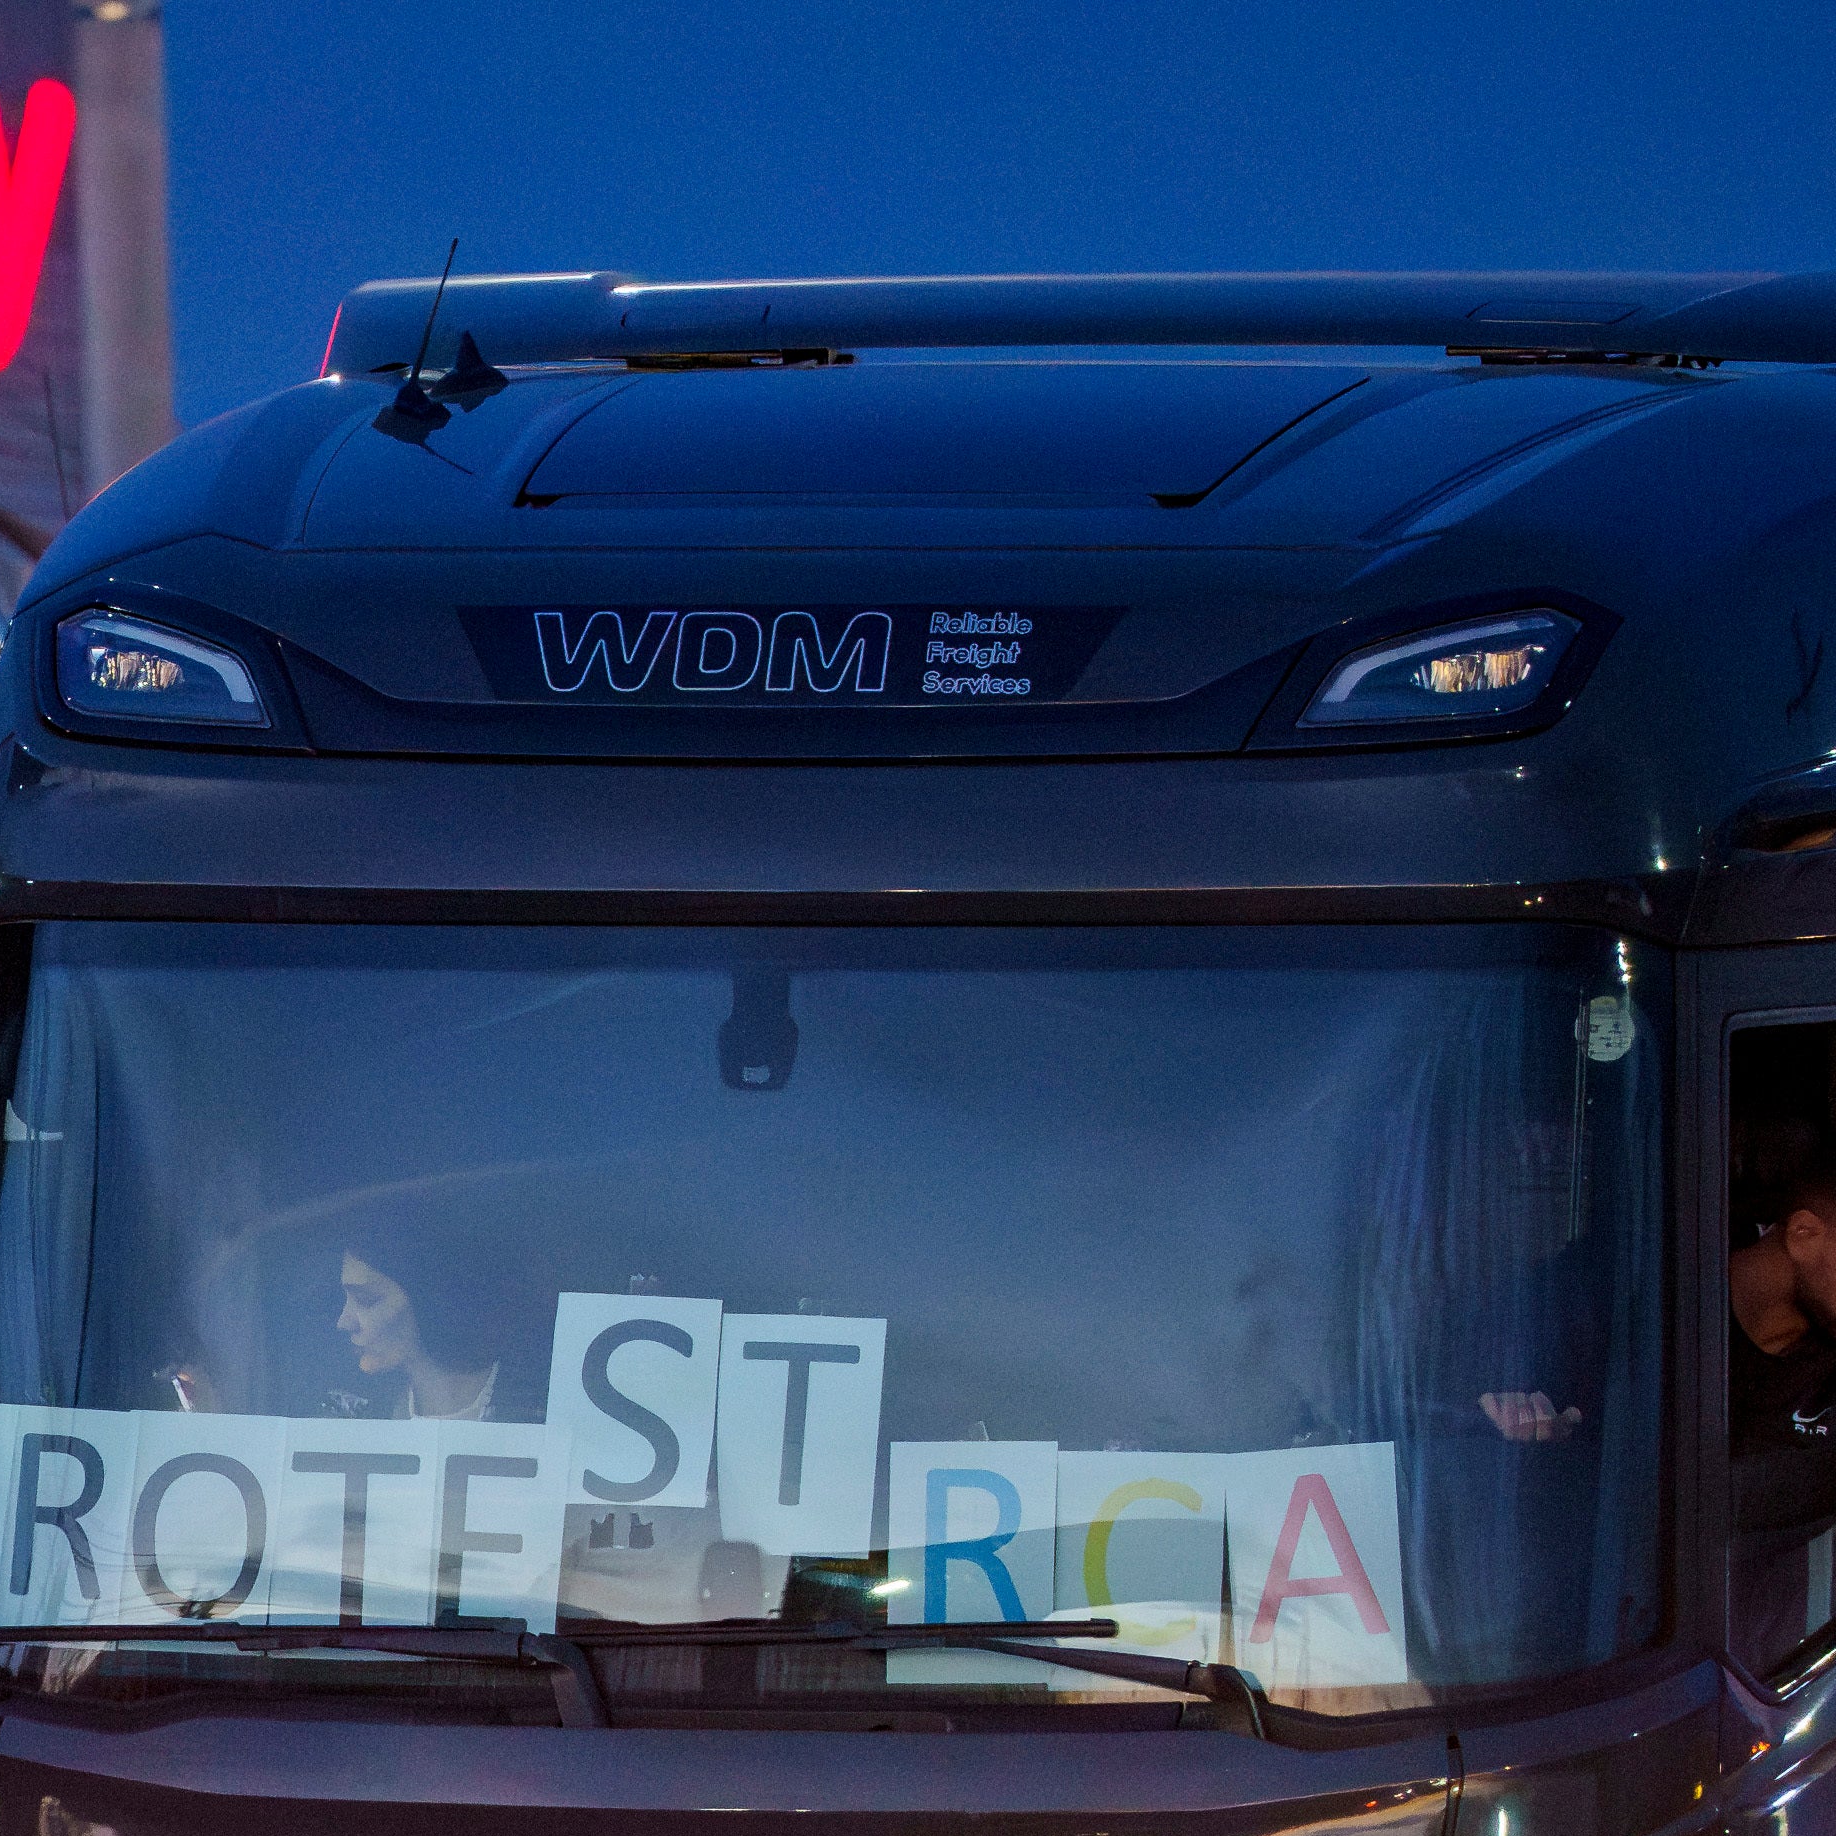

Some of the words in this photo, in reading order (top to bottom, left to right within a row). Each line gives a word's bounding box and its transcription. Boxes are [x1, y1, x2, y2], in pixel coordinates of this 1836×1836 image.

[929, 611, 1033, 635] Reliable
[533, 611, 893, 691] WDM
[926, 641, 1022, 668] Freight
[921, 671, 1031, 694] Services
[923, 1466, 1391, 1646] RCA
